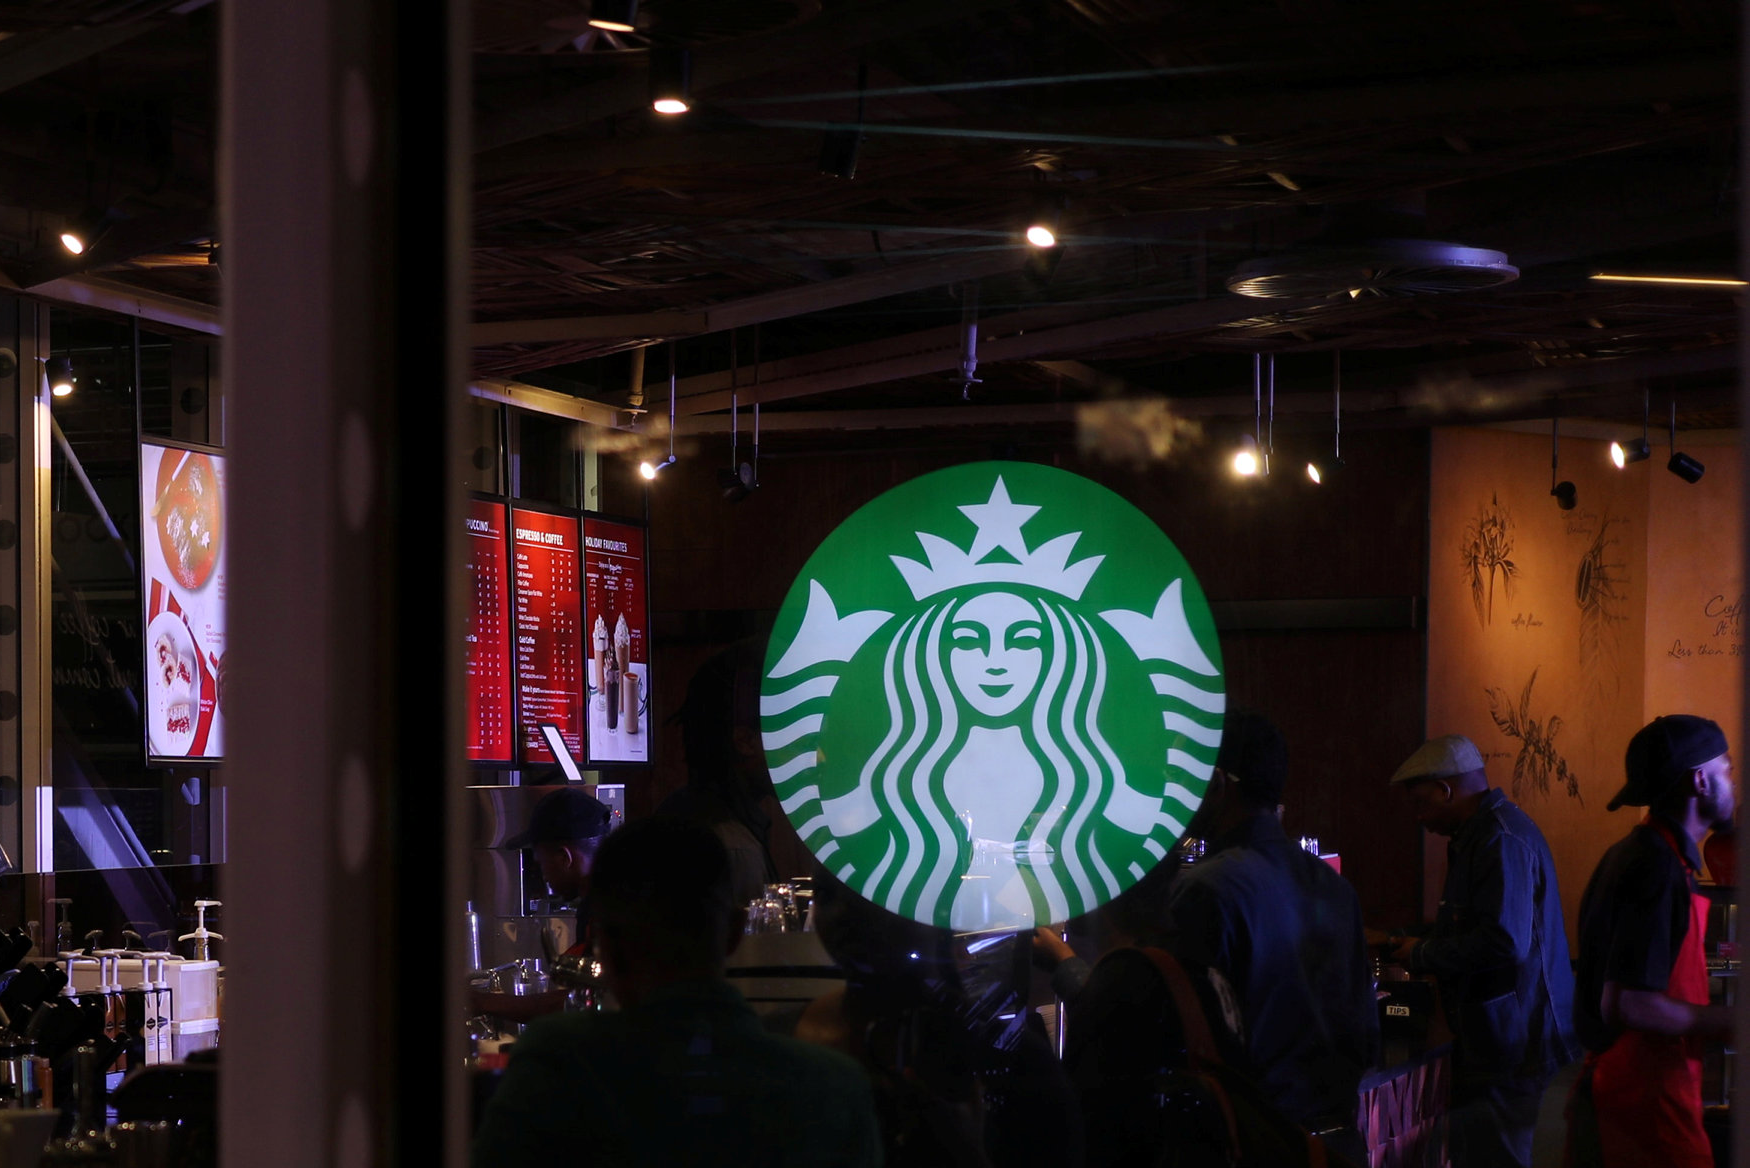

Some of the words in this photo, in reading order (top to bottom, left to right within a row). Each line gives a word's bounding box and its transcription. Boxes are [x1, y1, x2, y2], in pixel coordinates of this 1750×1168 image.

[515, 528, 540, 543] ESPRESSO
[545, 532, 564, 546] COFFEE
[1390, 1007, 1407, 1015] TIPS
